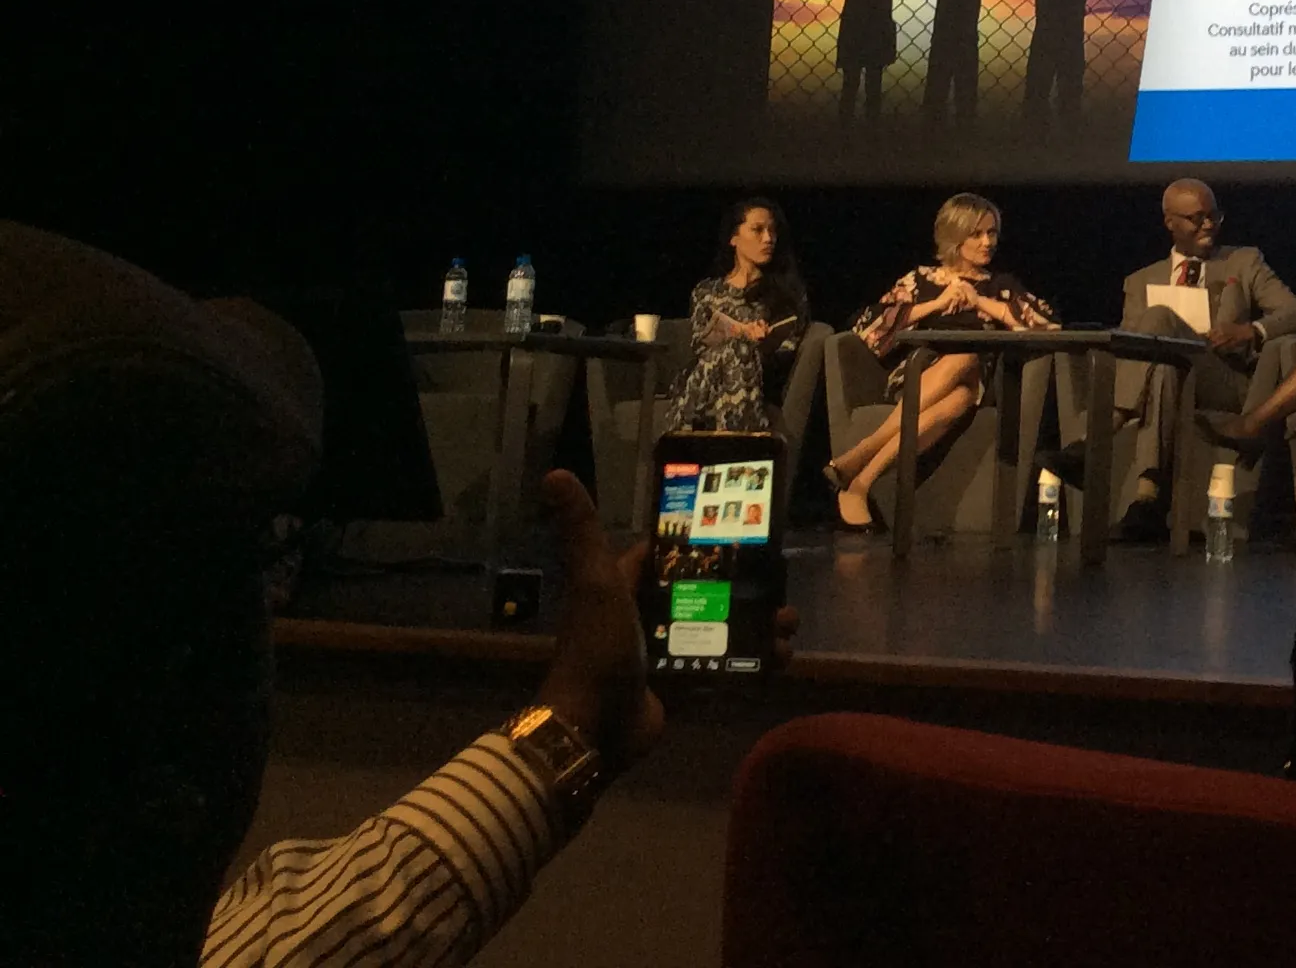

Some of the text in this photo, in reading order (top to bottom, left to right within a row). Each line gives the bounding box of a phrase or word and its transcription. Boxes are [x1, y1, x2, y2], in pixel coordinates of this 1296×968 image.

[1208, 21, 1284, 37] Consultatif
[1229, 46, 1247, 57] au
[1250, 43, 1279, 57] sein
[1250, 66, 1284, 82] pour
